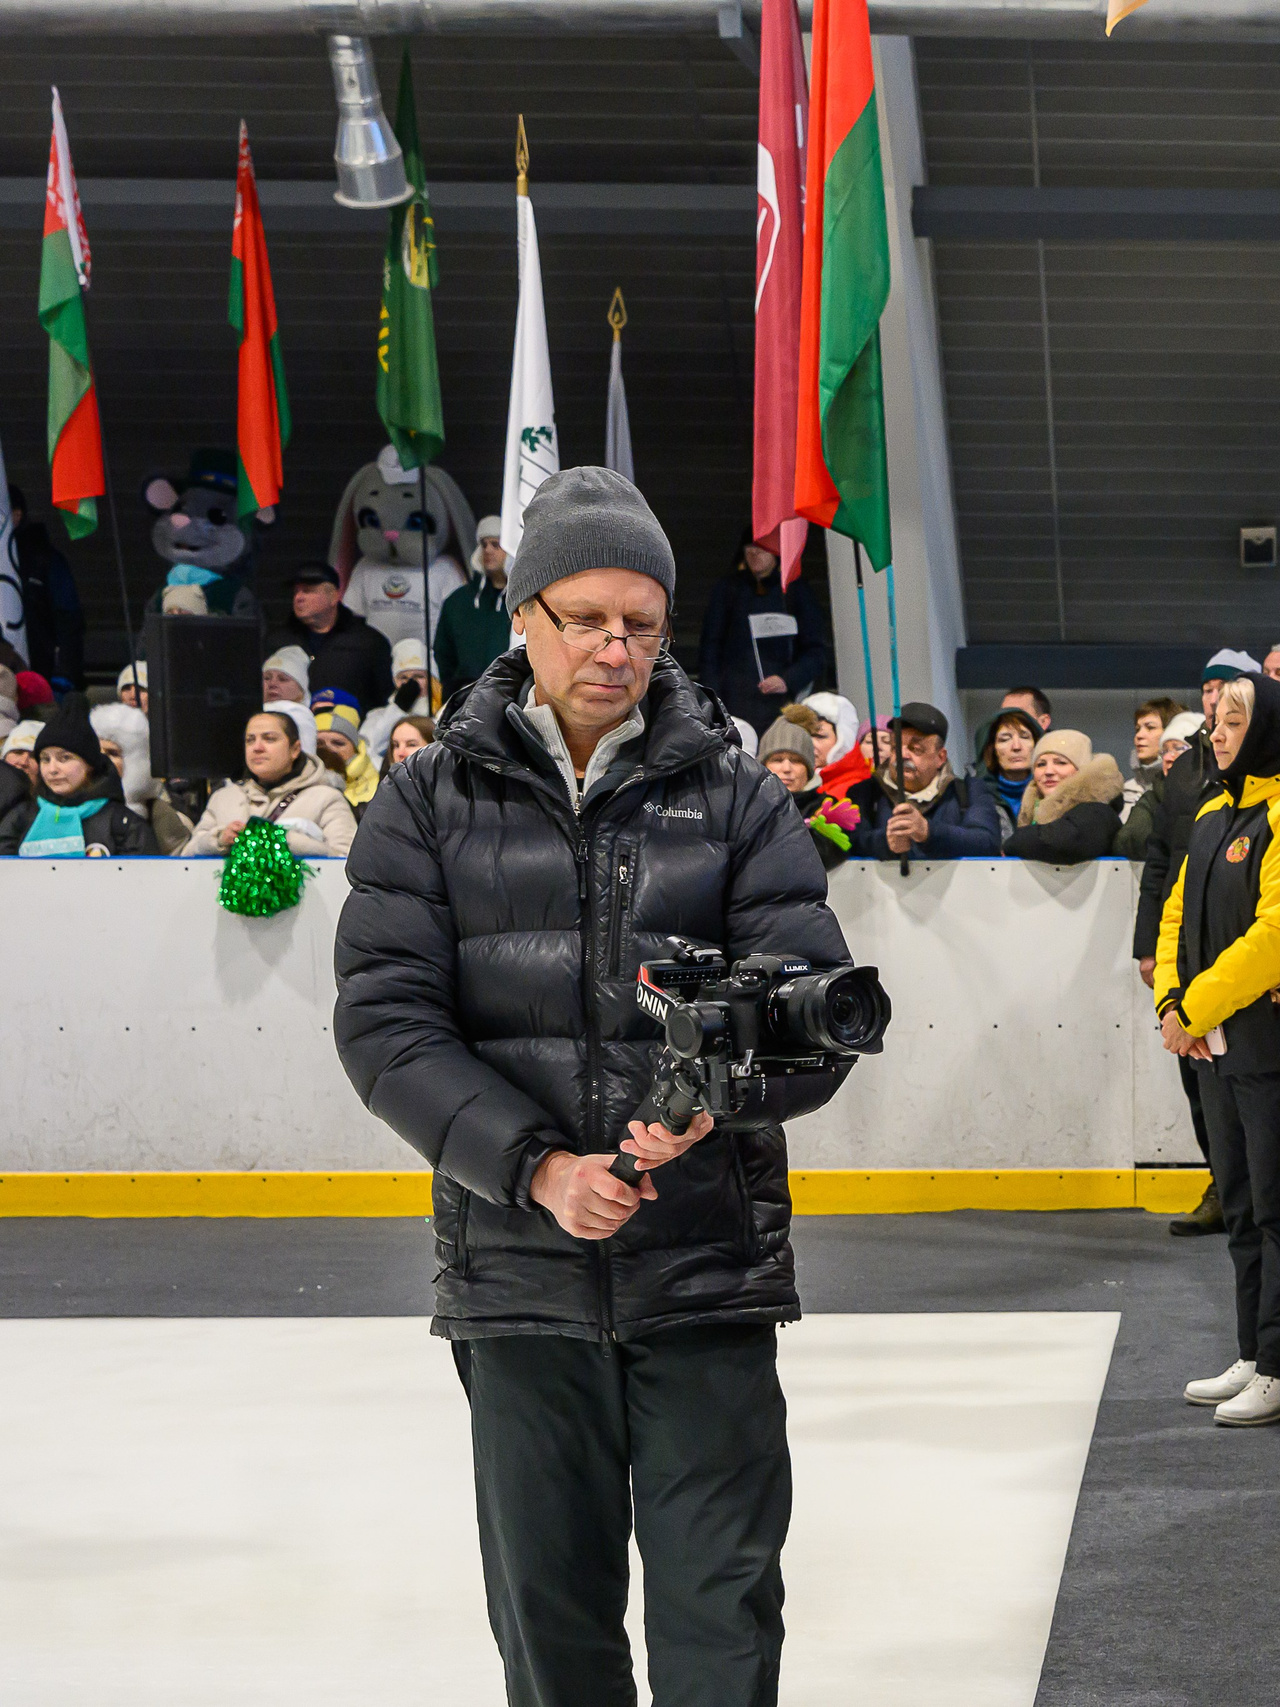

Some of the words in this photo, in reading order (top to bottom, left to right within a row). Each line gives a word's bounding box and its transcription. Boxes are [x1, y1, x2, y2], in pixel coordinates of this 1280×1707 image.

[655, 804, 703, 820] Columbia
[784, 964, 808, 972] LUMIX
[636, 985, 669, 1021] ONIN
